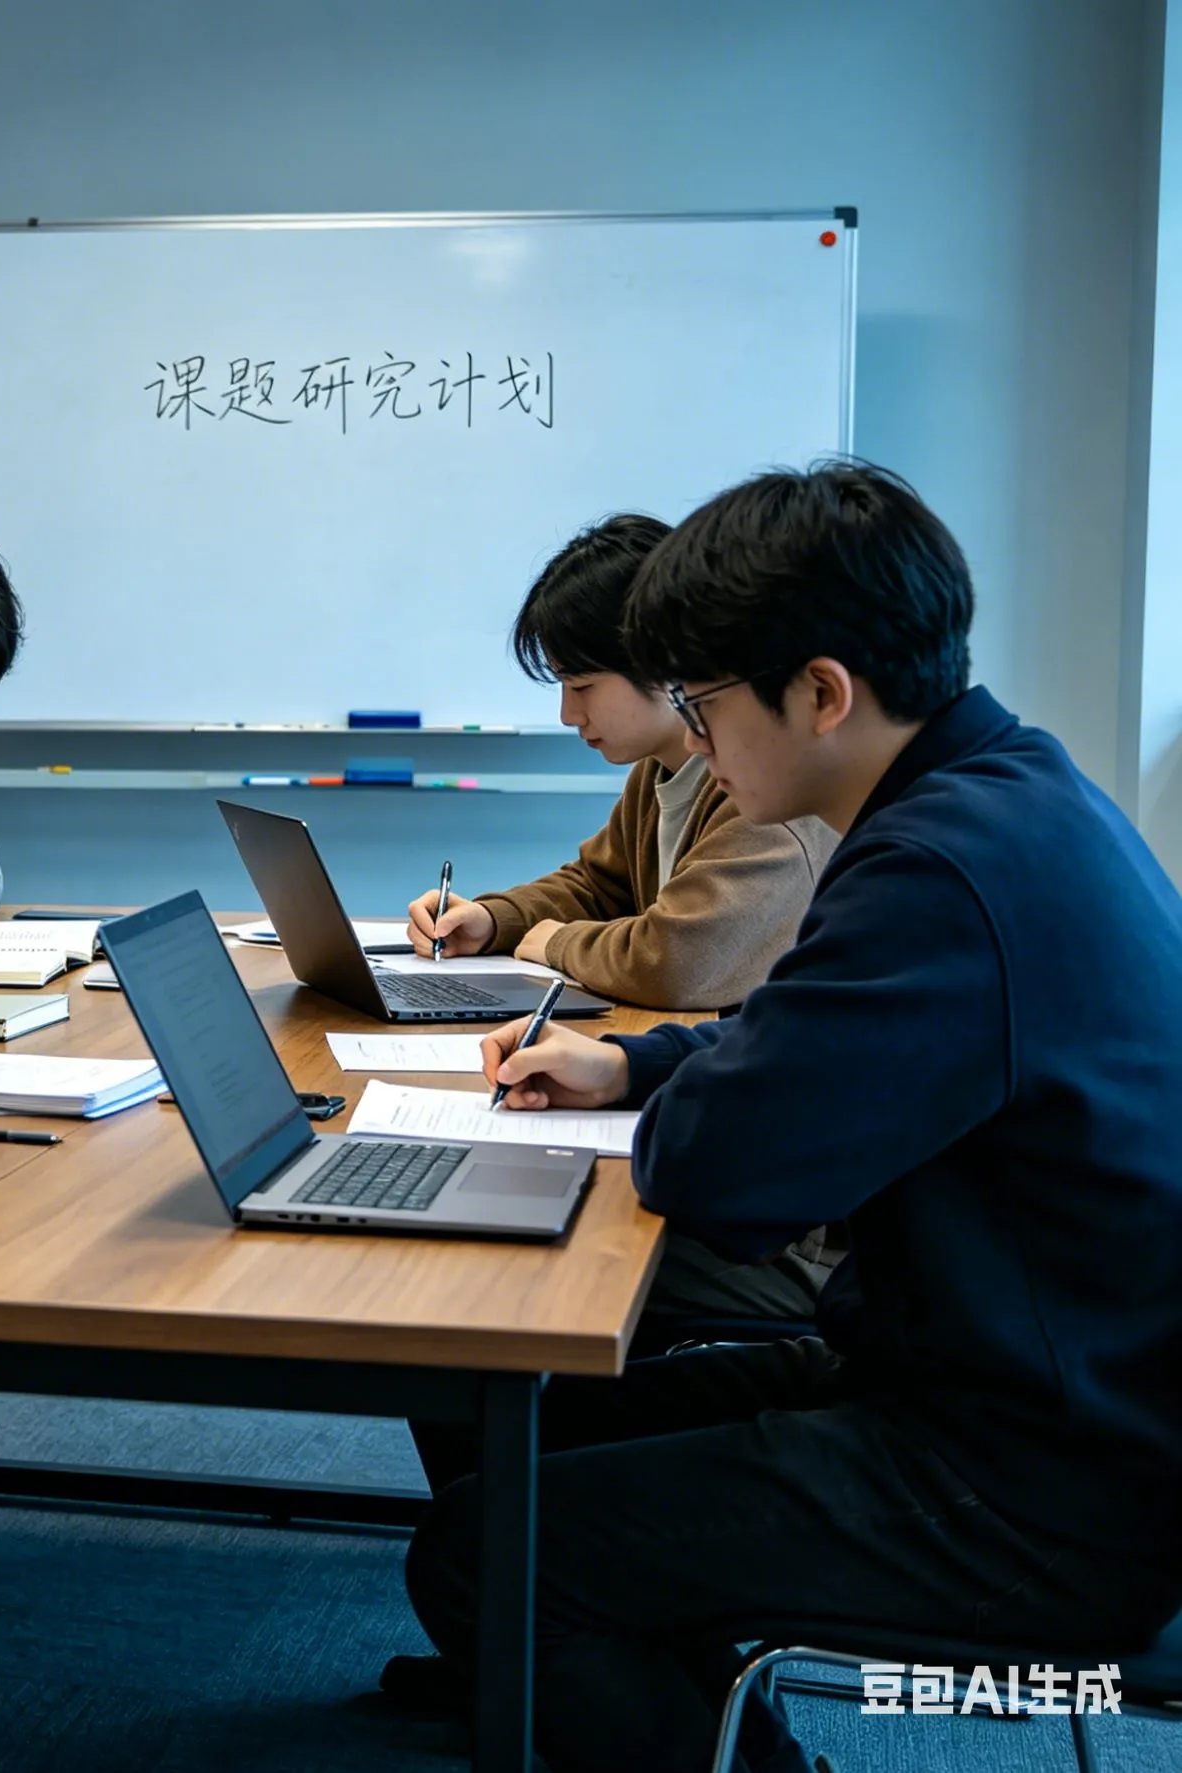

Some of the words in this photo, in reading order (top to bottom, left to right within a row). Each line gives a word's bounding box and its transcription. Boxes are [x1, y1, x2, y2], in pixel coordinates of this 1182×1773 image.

[144, 351, 553, 434] 课题研究计划
